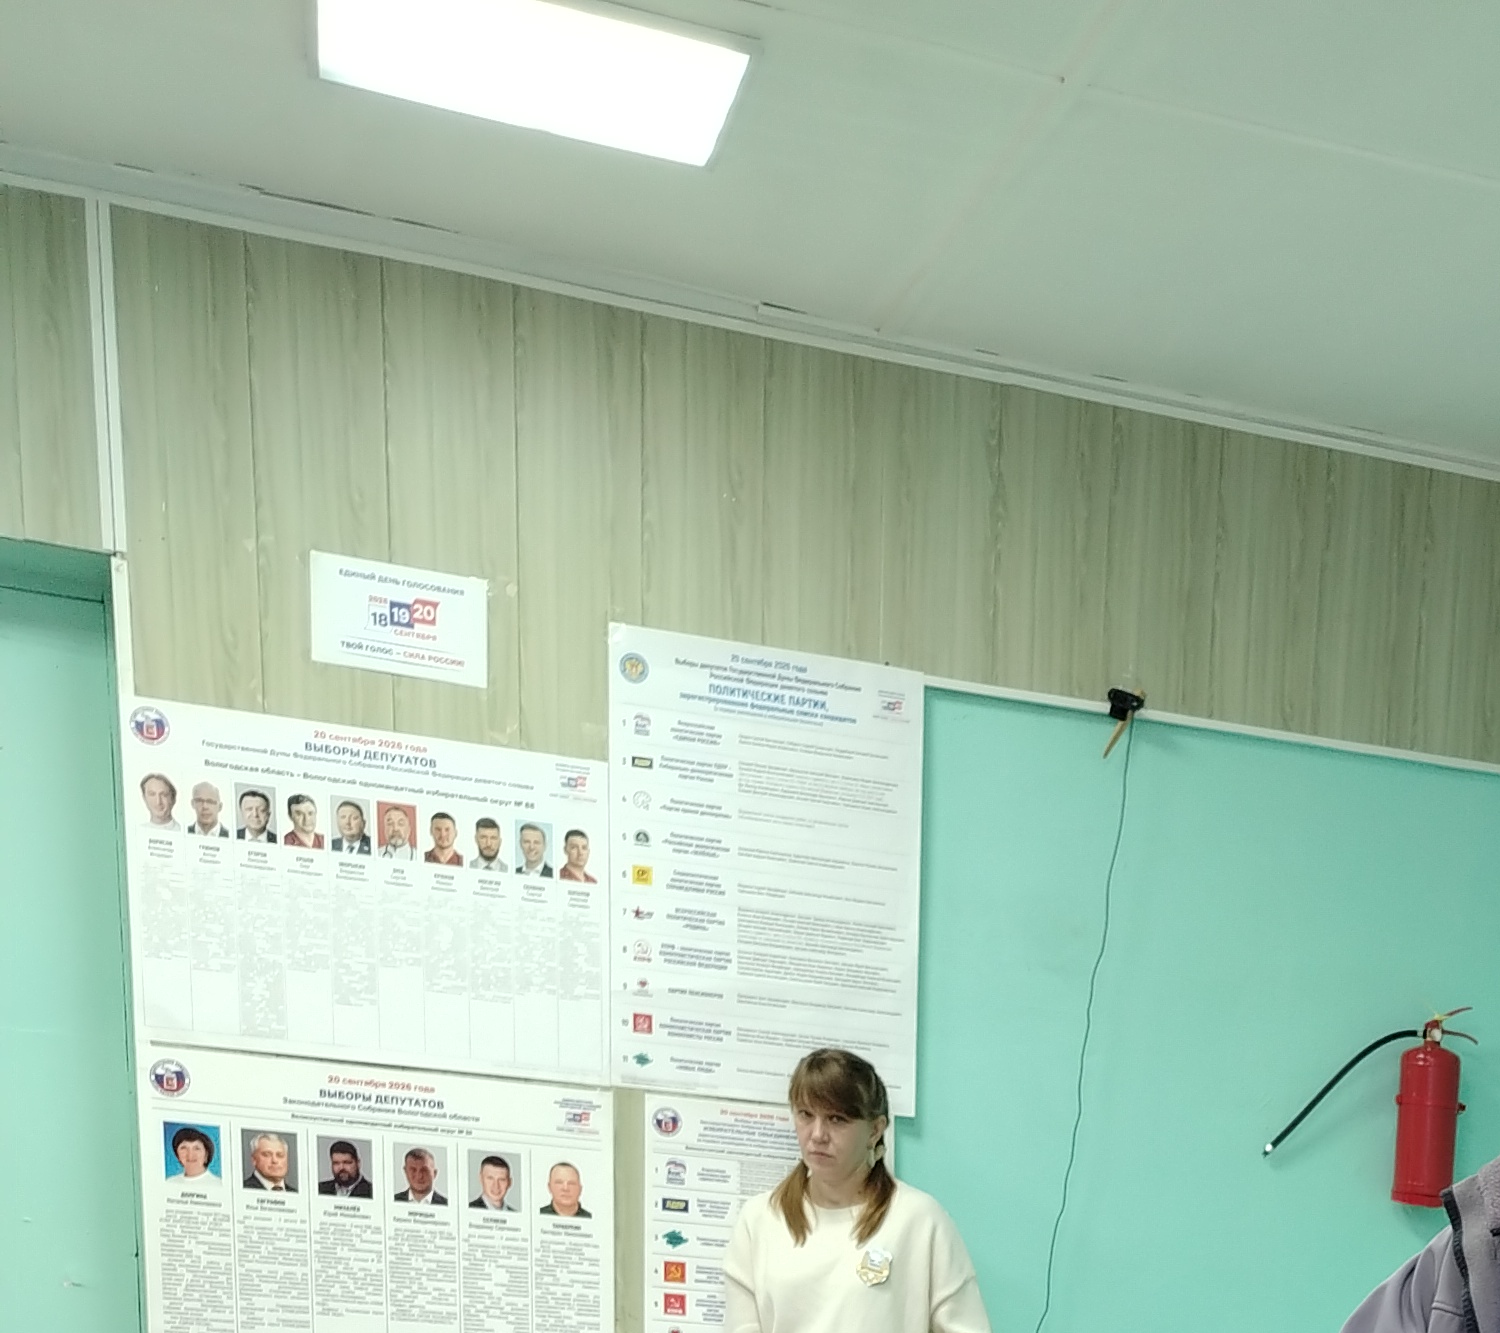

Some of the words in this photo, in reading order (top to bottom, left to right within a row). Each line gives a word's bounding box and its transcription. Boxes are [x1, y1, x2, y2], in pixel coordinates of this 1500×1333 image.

[338, 568, 376, 582] ЕДИНЫЙ
[378, 575, 400, 587] ДЕНЬ
[402, 579, 465, 596] ГОЛОСОВАНИЯ
[371, 612, 388, 628] 18
[391, 606, 410, 624] 19
[412, 604, 435, 621] 20
[394, 628, 438, 642] СЕНТЯБРЯ
[340, 640, 364, 650] ТВОЙ
[365, 644, 394, 656] ГОЛОС
[403, 650, 426, 661] СИЛА
[708, 683, 786, 705] ПОЛИТИЧЕСКИЕ
[788, 694, 830, 712] ПАРТИИ,
[328, 732, 376, 747] сентября
[304, 742, 360, 758] ВЫБОРЫ
[363, 749, 438, 769] ДЕПУТАТОВ
[327, 1074, 340, 1084] 20
[342, 1076, 386, 1090] сентября
[319, 1088, 372, 1103] ВЫБОРЫ
[374, 1094, 445, 1110] ДЕПУТАТОВ
